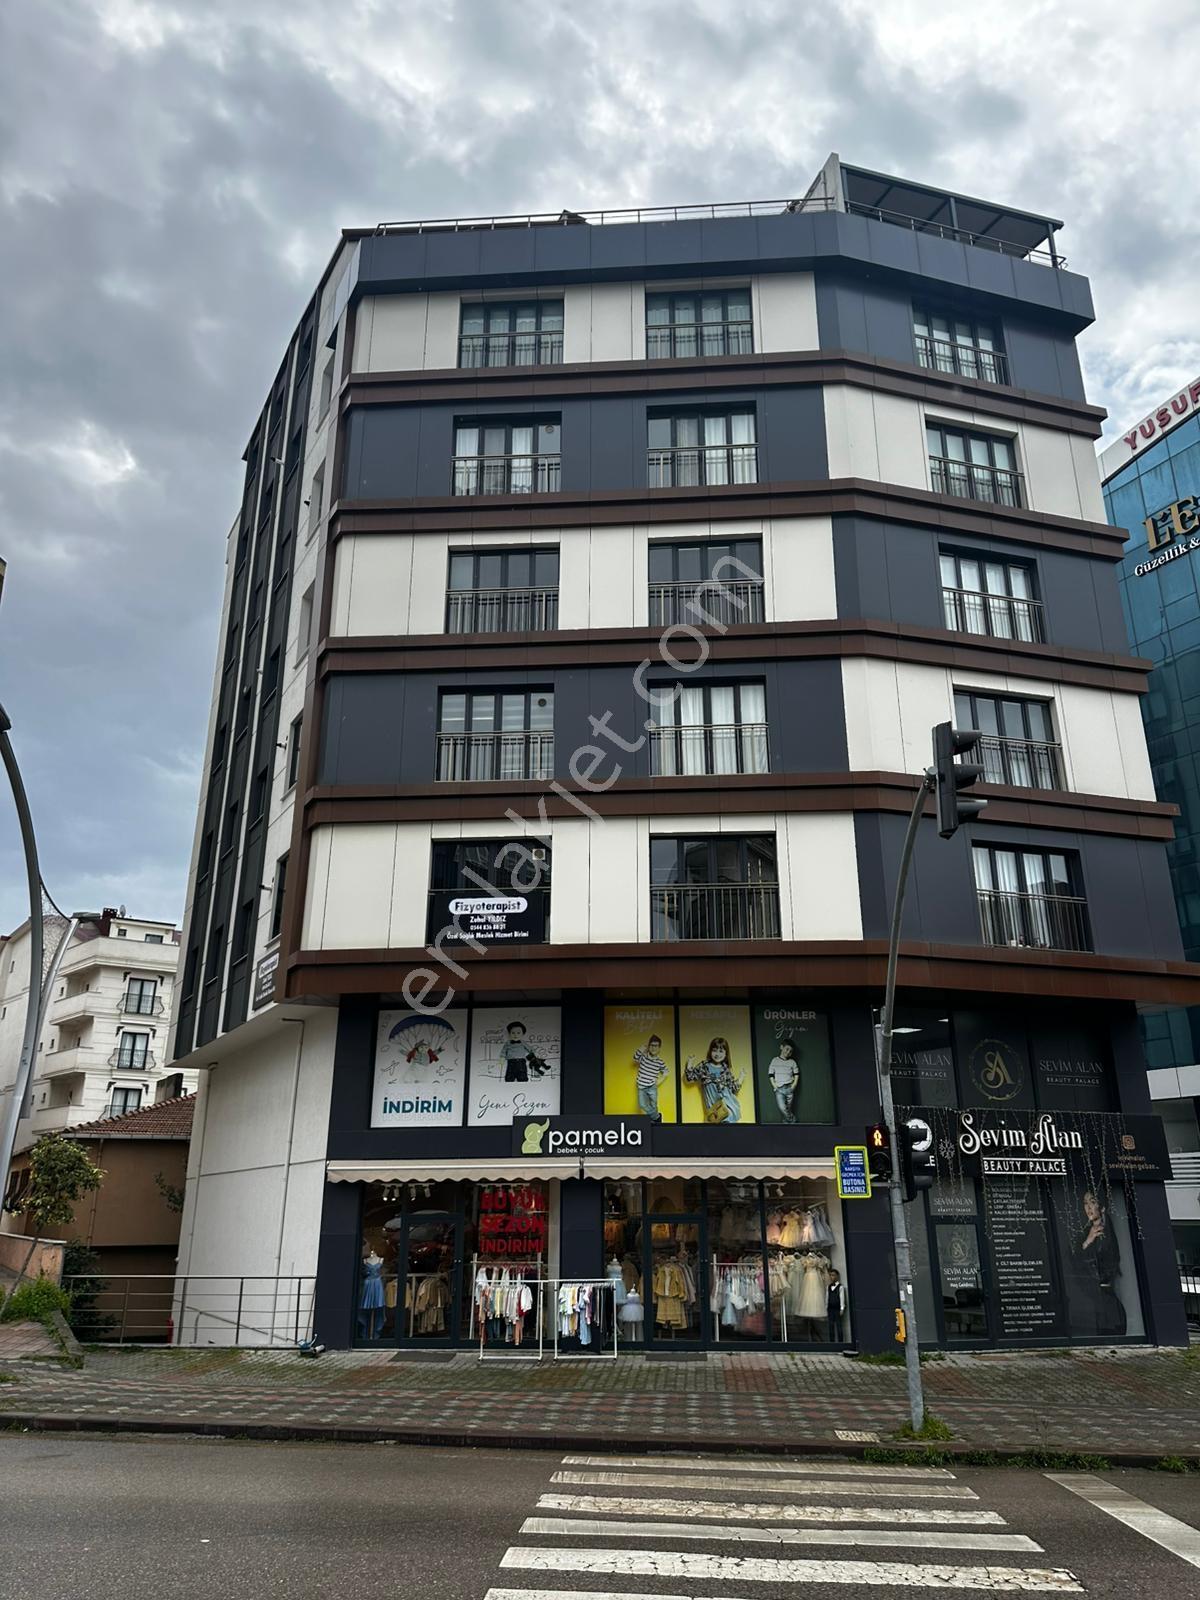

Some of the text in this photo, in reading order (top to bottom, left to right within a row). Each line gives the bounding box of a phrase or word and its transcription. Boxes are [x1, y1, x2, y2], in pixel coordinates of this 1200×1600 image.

[1134, 543, 1188, 576] Güzellik
[455, 901, 521, 913] Fizyoterapist
[764, 1009, 817, 1020] ÜRÜNLER
[1075, 1060, 1104, 1073] ALAN
[383, 1096, 453, 1114] İNDİRİM
[477, 1093, 550, 1119] Yeni Sezon
[548, 1122, 642, 1153] pamela
[960, 1113, 1083, 1155] Sevim Alan
[983, 1160, 1067, 1172] BEAUTY PALACE
[480, 1213, 545, 1233] SEZON
